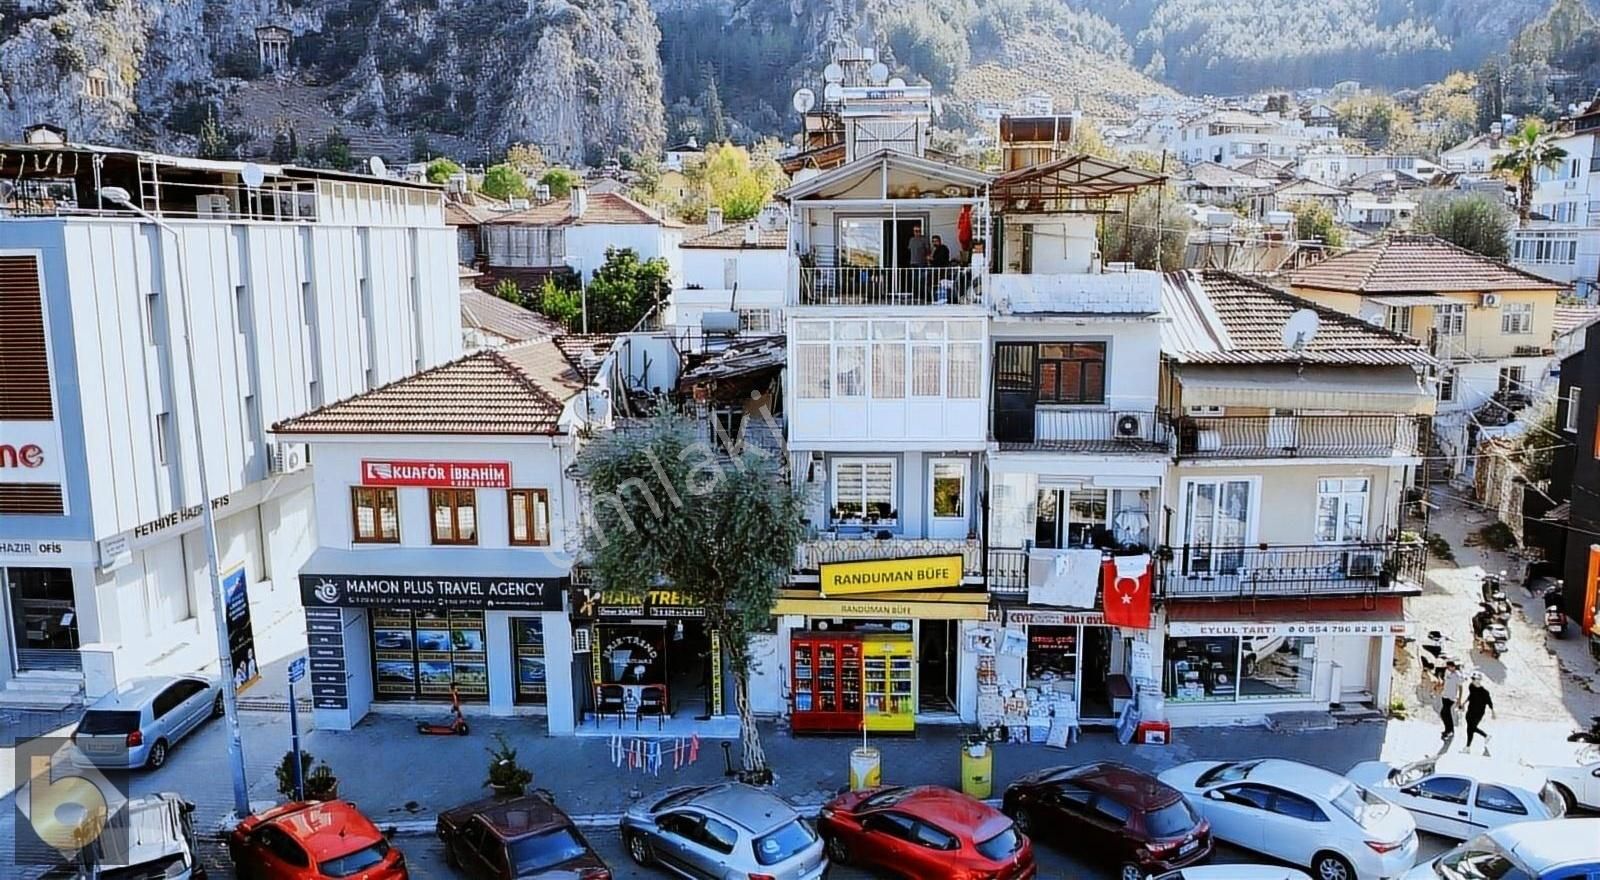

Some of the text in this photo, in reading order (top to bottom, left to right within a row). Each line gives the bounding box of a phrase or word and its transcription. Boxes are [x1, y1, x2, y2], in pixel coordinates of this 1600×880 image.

[392, 463, 505, 480] KUAFÖR İBRAHİM
[0, 543, 31, 553] HAZIR
[834, 567, 949, 586] RANDUMAN BÜFE
[346, 579, 544, 596] MAMON PLUS TRAVEL AGENCY
[841, 603, 890, 614] RANDUMAN
